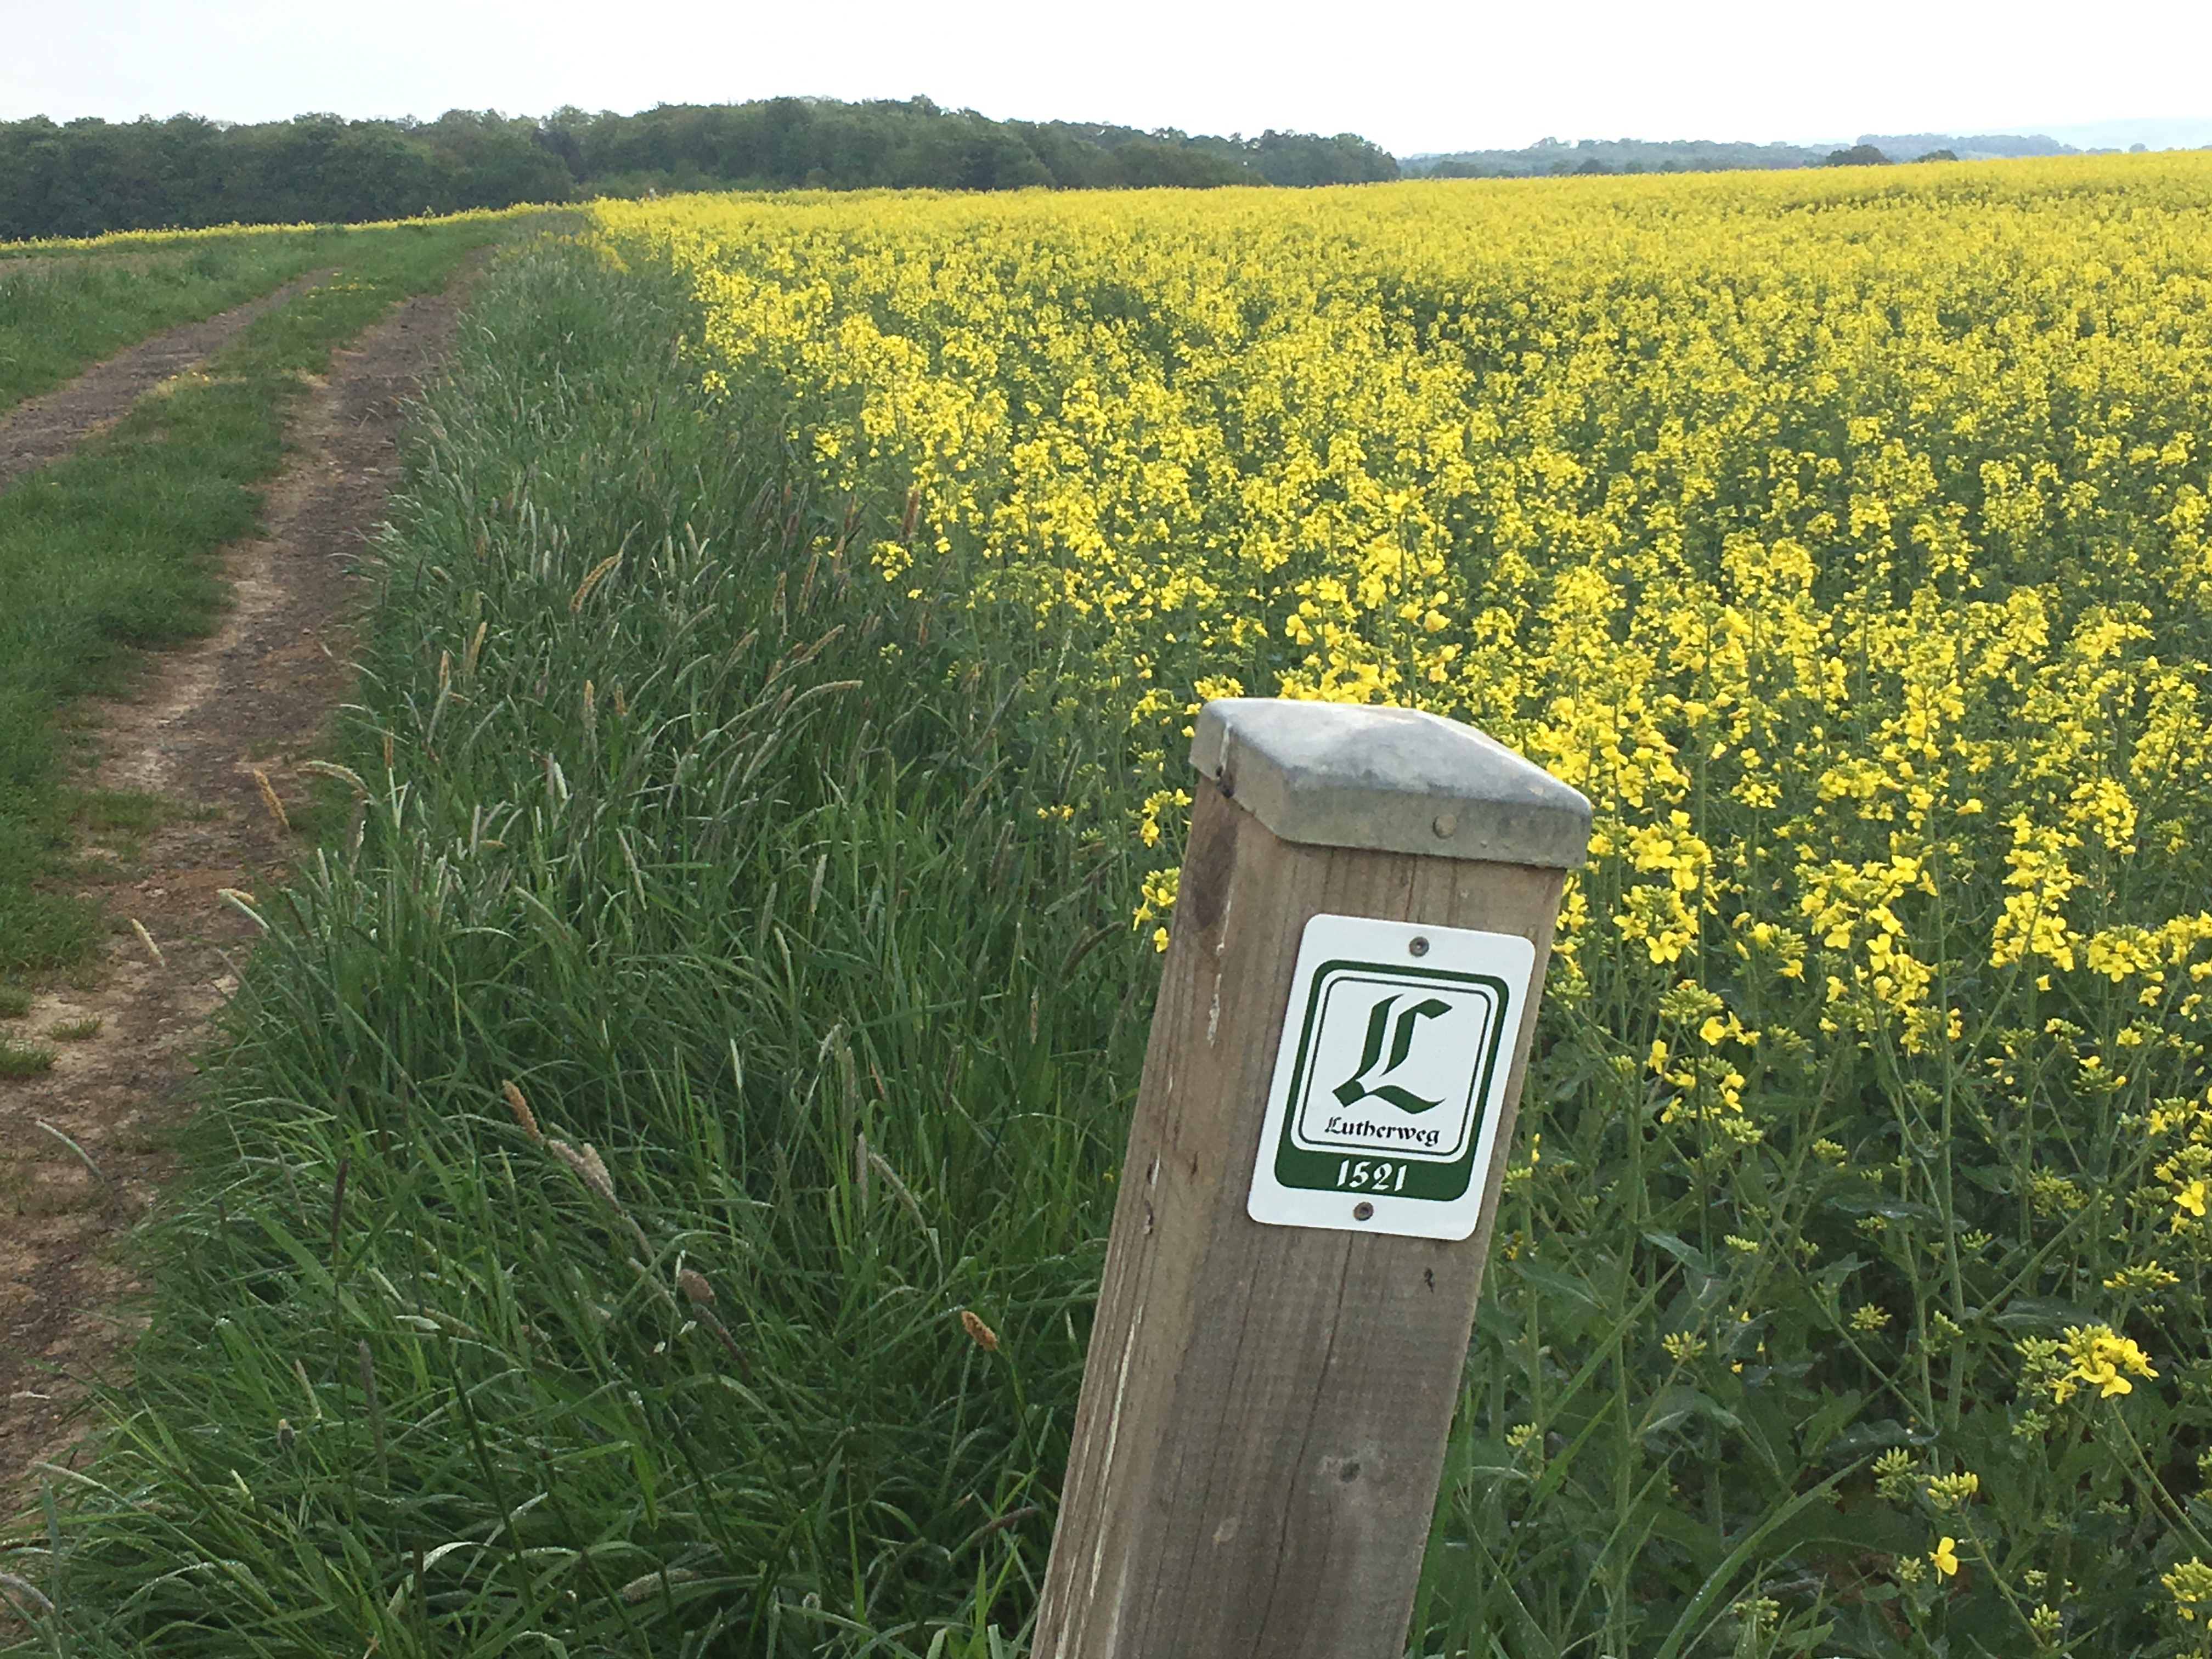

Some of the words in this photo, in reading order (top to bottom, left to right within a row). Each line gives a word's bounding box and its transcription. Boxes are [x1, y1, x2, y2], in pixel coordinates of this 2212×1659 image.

[1332, 993, 1453, 1115] L
[1324, 1116, 1440, 1147] Lutherweg
[1336, 1159, 1408, 1192] 1521
